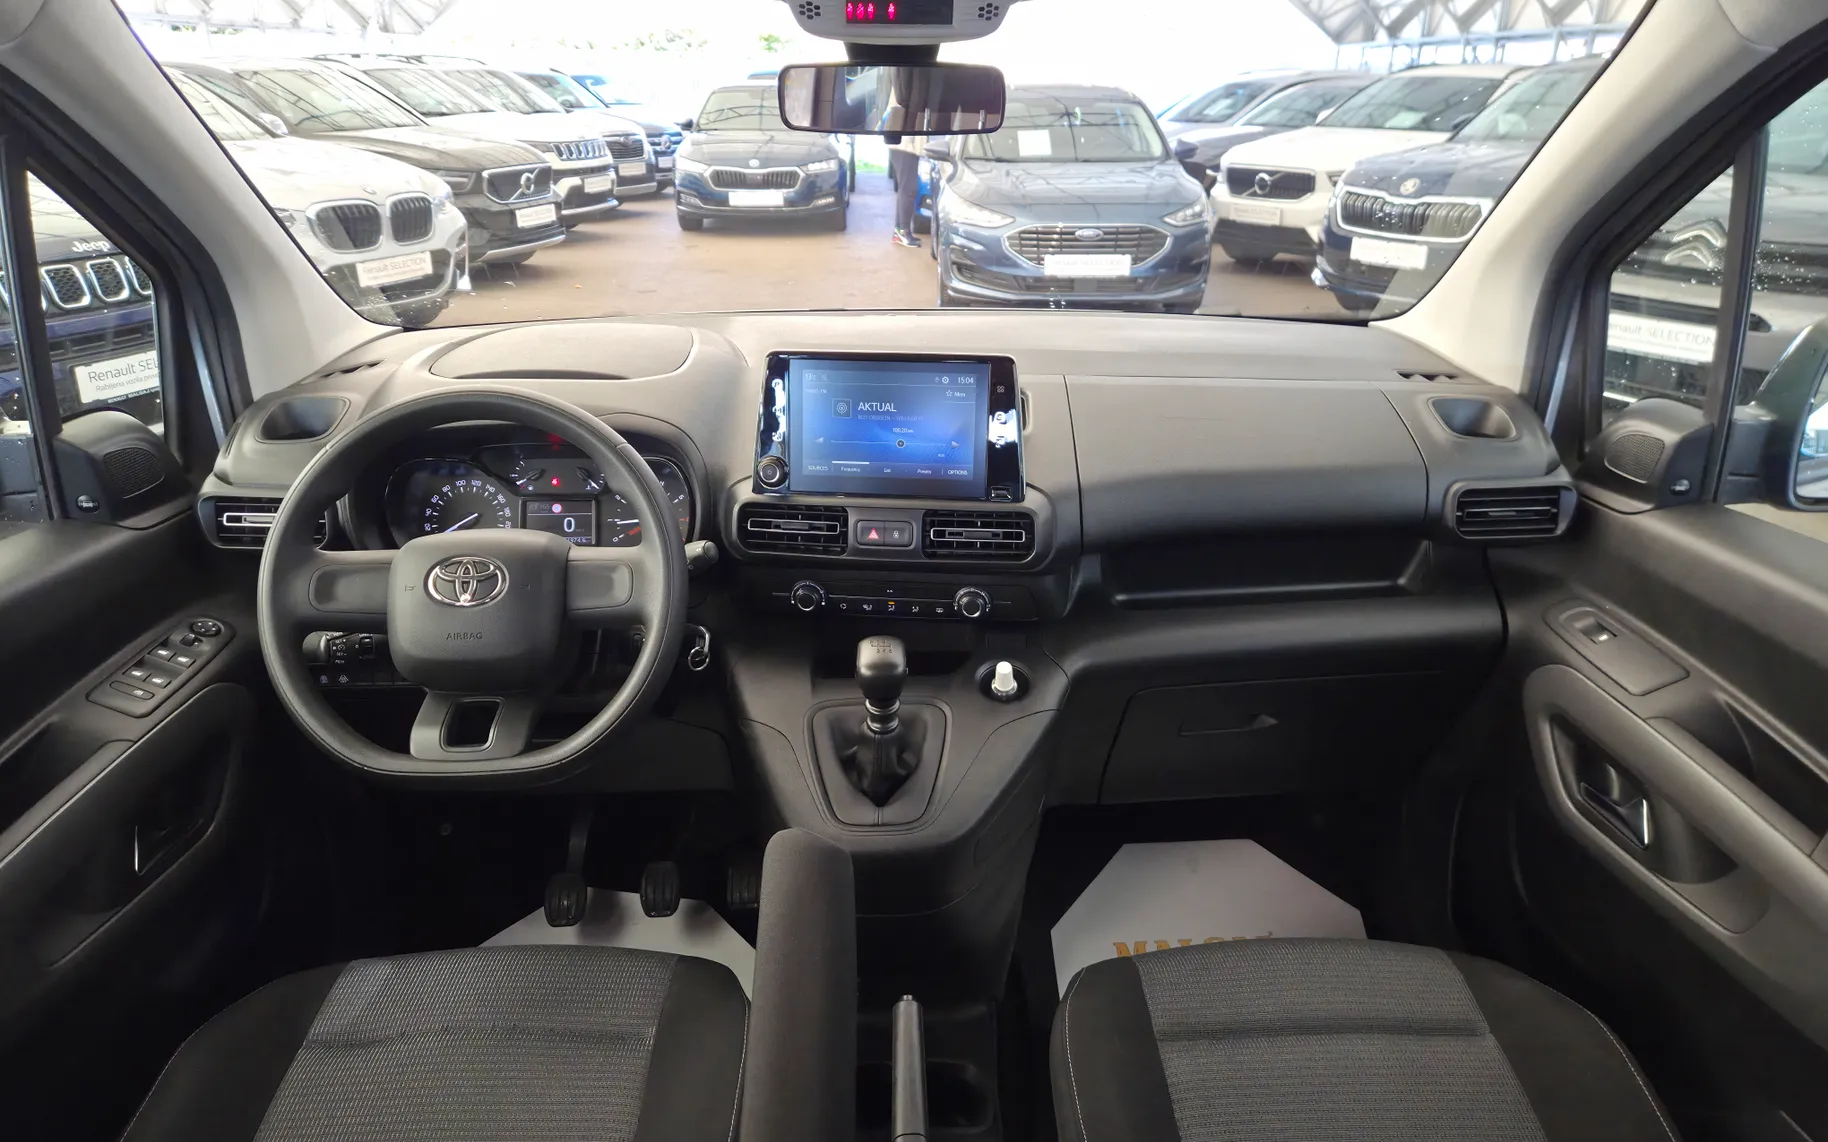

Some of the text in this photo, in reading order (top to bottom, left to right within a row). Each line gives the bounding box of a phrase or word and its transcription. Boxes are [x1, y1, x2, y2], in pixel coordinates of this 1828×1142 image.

[71, 240, 110, 252] Jeep
[1647, 326, 1714, 346] SELECTION
[87, 363, 136, 384] Renault
[956, 376, 974, 384] 15:04
[857, 402, 897, 412] AKTUAL
[455, 479, 467, 487] 100
[471, 479, 482, 487] 120
[485, 483, 496, 492] 140
[441, 484, 451, 493] 80
[563, 517, 575, 532] 0
[446, 632, 483, 641] AIRBAG
